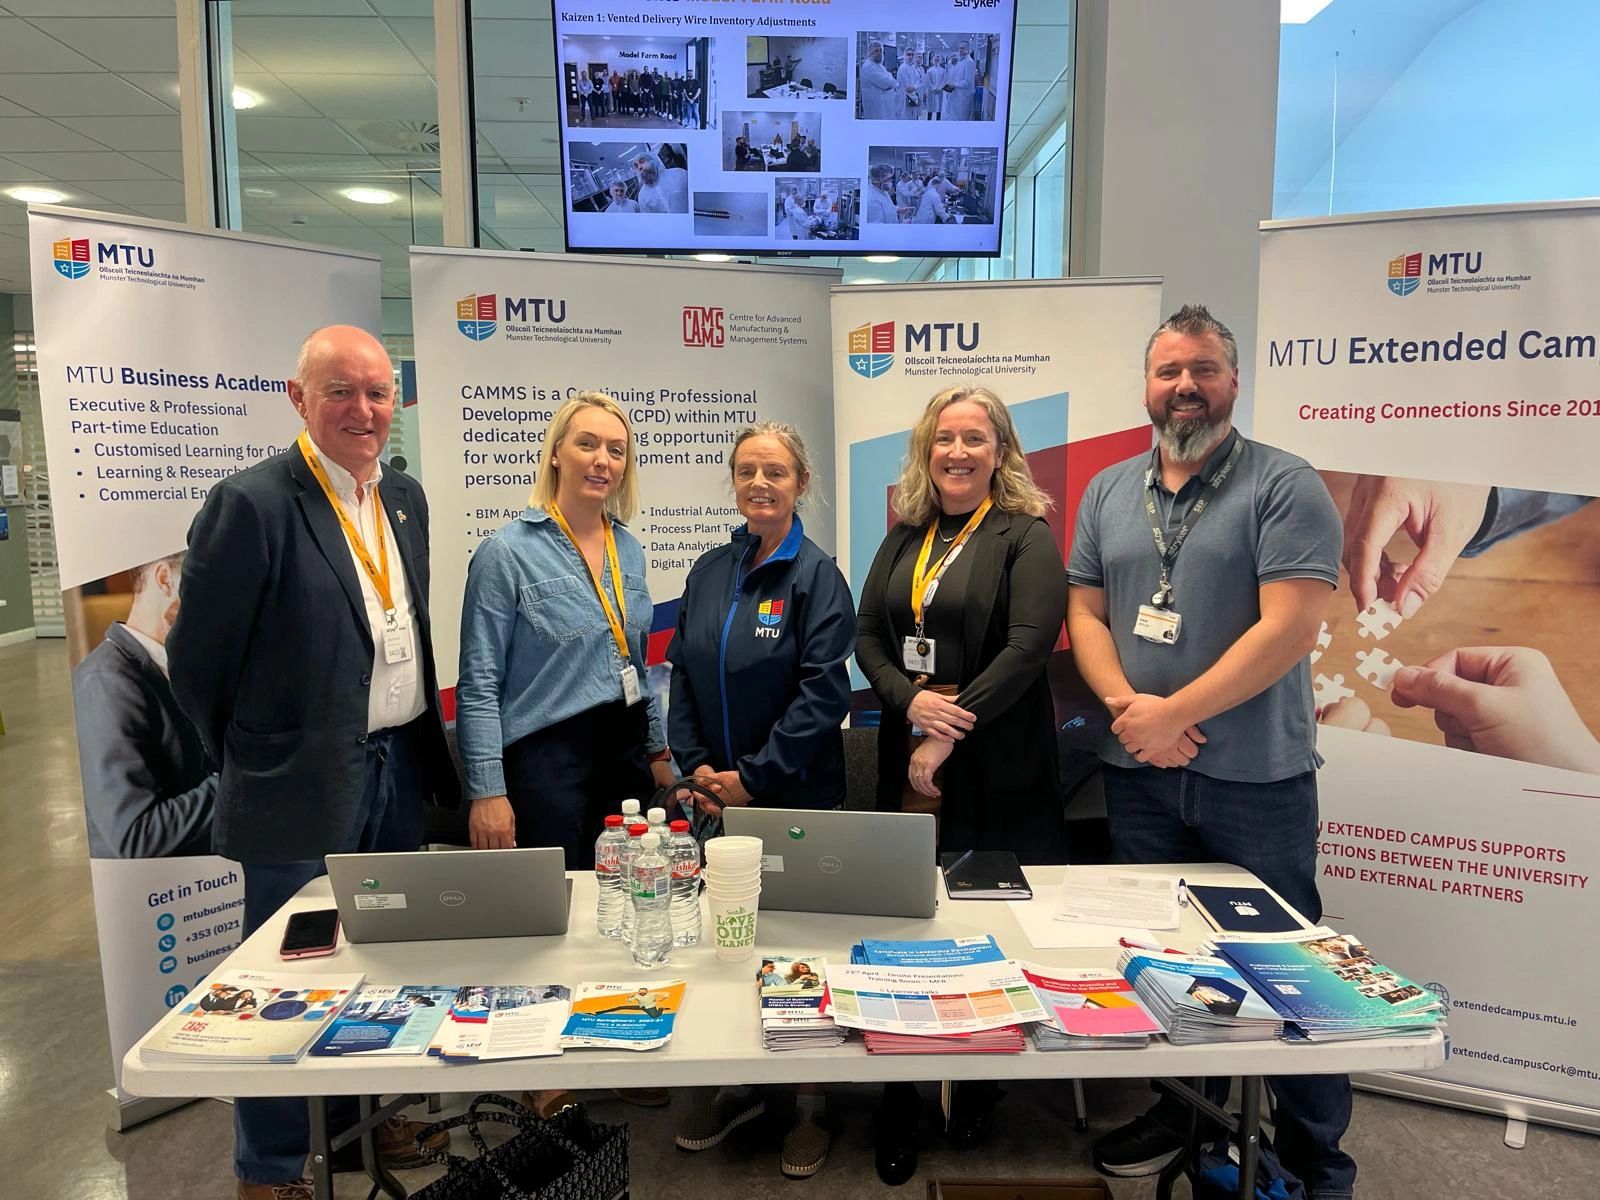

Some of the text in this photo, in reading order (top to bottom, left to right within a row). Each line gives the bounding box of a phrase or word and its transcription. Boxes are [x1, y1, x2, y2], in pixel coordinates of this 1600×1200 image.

[561, 12, 816, 28] Kaizen 1: Vented Delivery Wire Inventory Adjustments
[619, 51, 640, 59] Model
[97, 242, 154, 268] MTU
[1428, 251, 1483, 276] MTU
[99, 273, 197, 291] Munster Technological University
[1427, 283, 1521, 295] Munster Technological University
[505, 297, 566, 323] MTU
[729, 312, 801, 325] Centre for Advanced
[505, 325, 531, 334] Ollscoil
[594, 327, 622, 336] Mumhan
[729, 324, 781, 336] Manufacturing
[905, 322, 980, 353] MTU
[505, 334, 612, 346] Munster Technological University
[729, 335, 808, 347] Management Systems
[1269, 337, 1337, 368] MTU
[1349, 330, 1508, 365] Extended
[905, 355, 935, 365] Ollscoil
[1014, 353, 1050, 363] Mumhan
[904, 364, 1036, 377] Munster Technological University
[66, 365, 287, 394] MTU Business Academ
[461, 386, 527, 401] CAMMS
[533, 386, 545, 401] is
[551, 390, 561, 401] a
[660, 389, 758, 404] Professional
[69, 397, 248, 417] Executive & Professional
[1298, 402, 1376, 424] Creating
[1380, 401, 1502, 420] Connections
[1507, 399, 1561, 418] Since
[462, 407, 757, 425] Developme (CPD) within MTU
[71, 419, 219, 436] Part-time Education
[94, 443, 182, 457] Customised
[185, 444, 244, 461] Learning
[246, 445, 265, 457] for
[464, 450, 489, 465] for
[635, 452, 690, 468] pment
[695, 450, 723, 465] and
[97, 465, 162, 482] Learning
[166, 467, 177, 478] &
[465, 471, 536, 488] personal
[1211, 462, 1232, 489] stryker
[99, 486, 188, 501] Commercial
[476, 508, 499, 519] BIM
[649, 505, 702, 517] Industrial
[1193, 499, 1206, 513] SEP
[650, 522, 721, 534] Process Plant
[650, 541, 674, 552] Data
[1167, 525, 1189, 555] stryker
[650, 558, 685, 572] Digital
[755, 626, 780, 639] MTU
[1327, 821, 1406, 843] EXTENDED
[1410, 832, 1477, 852] CAMPUS
[1480, 840, 1566, 864] SUPPORTS
[1380, 850, 1453, 872] BETWEEN
[1457, 860, 1489, 876] THE
[1492, 863, 1589, 889] UNIVERSITY
[148, 871, 238, 909] Get in Touch
[1323, 864, 1524, 904] AND EXTERNAL PARTNERS
[184, 920, 240, 944] +353 (0)21
[716, 924, 754, 940] OUR
[1453, 998, 1577, 1028] extendedcampus.mtu.ie
[1452, 1045, 1600, 1080] extended.campusCork@mtu.
